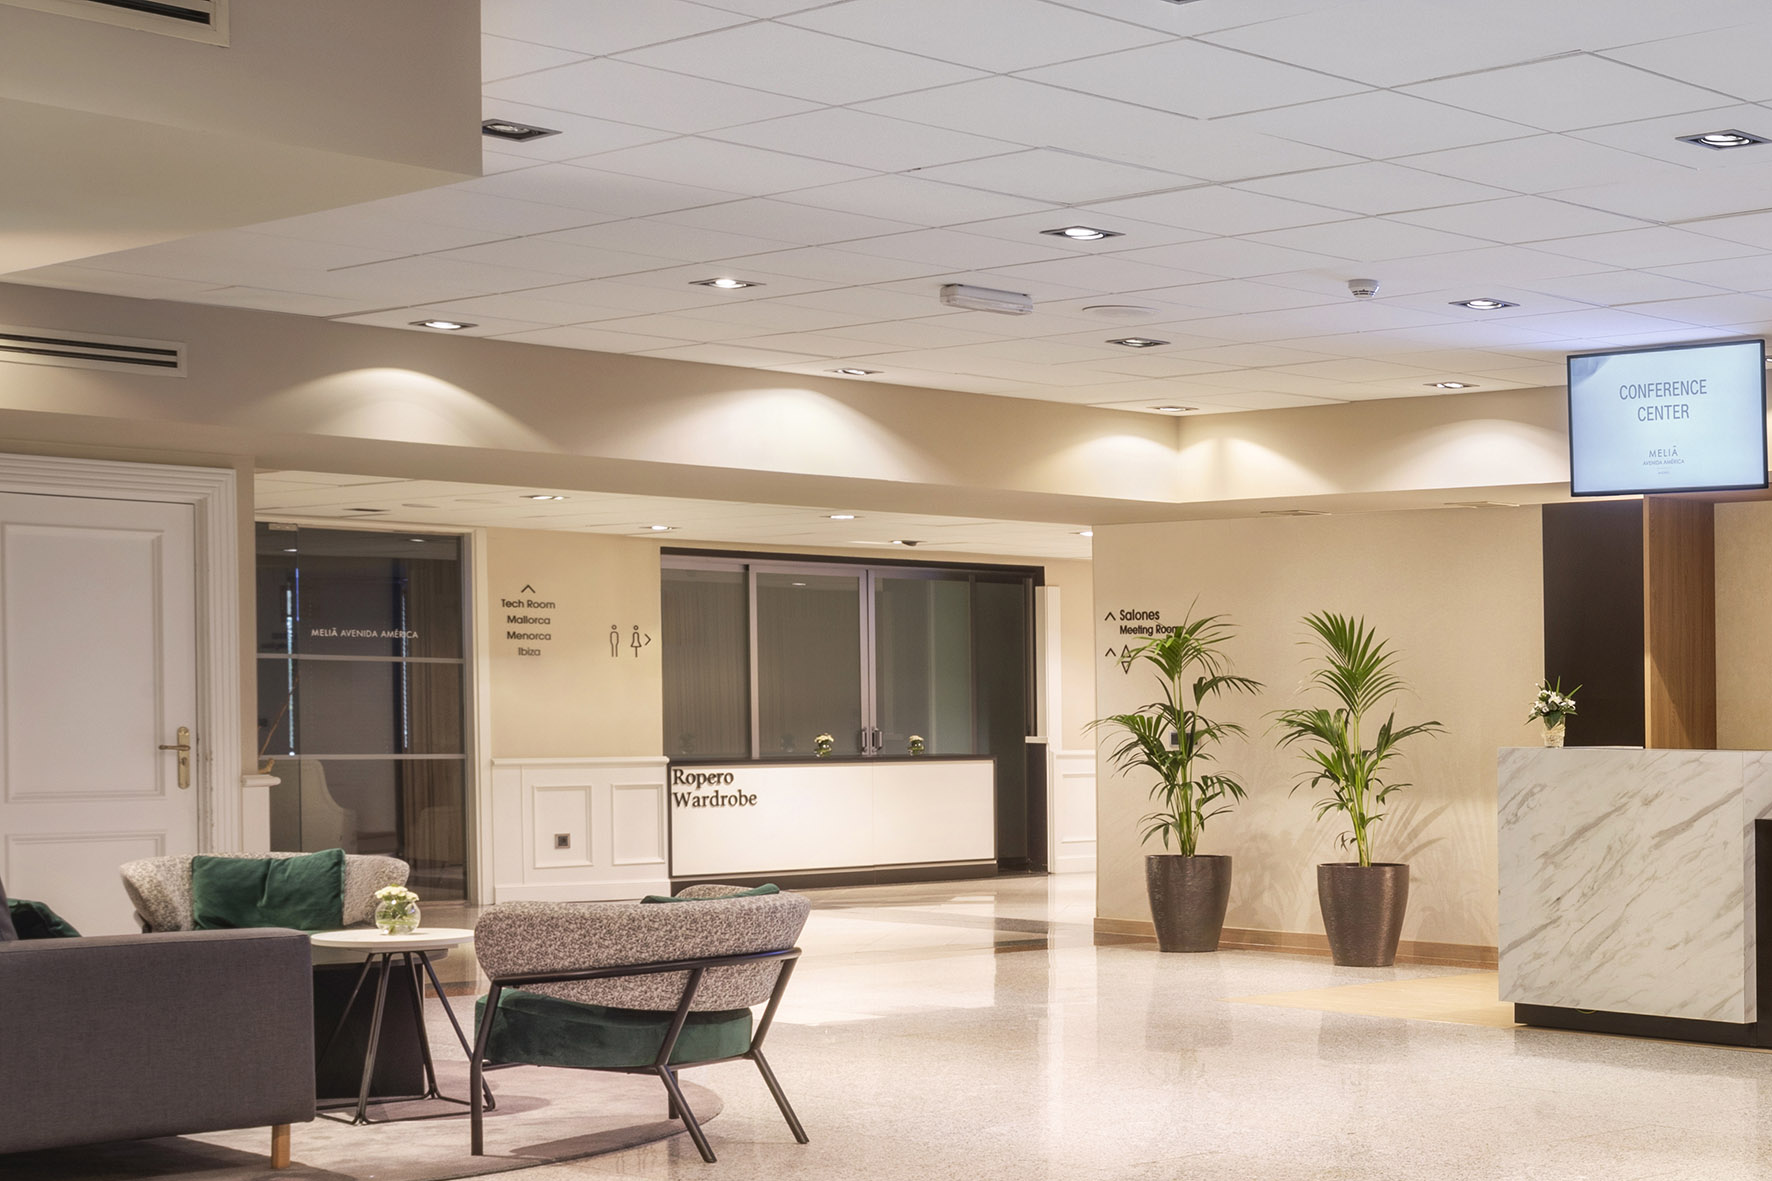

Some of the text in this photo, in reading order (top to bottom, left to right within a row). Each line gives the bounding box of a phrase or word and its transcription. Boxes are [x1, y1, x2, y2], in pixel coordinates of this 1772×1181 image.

[1619, 379, 1707, 400] CONFERENCE
[1637, 404, 1690, 421] CENTER
[500, 598, 556, 609] Tech Room
[506, 615, 551, 625] Mallorca
[1119, 609, 1160, 621] Salones
[340, 629, 378, 638] AVENIDA
[506, 631, 552, 641] Menorca
[1119, 625, 1154, 637] Meeting
[518, 647, 541, 656] Ibiza
[672, 768, 734, 790] Ropero
[672, 789, 758, 808] Wardrobe
